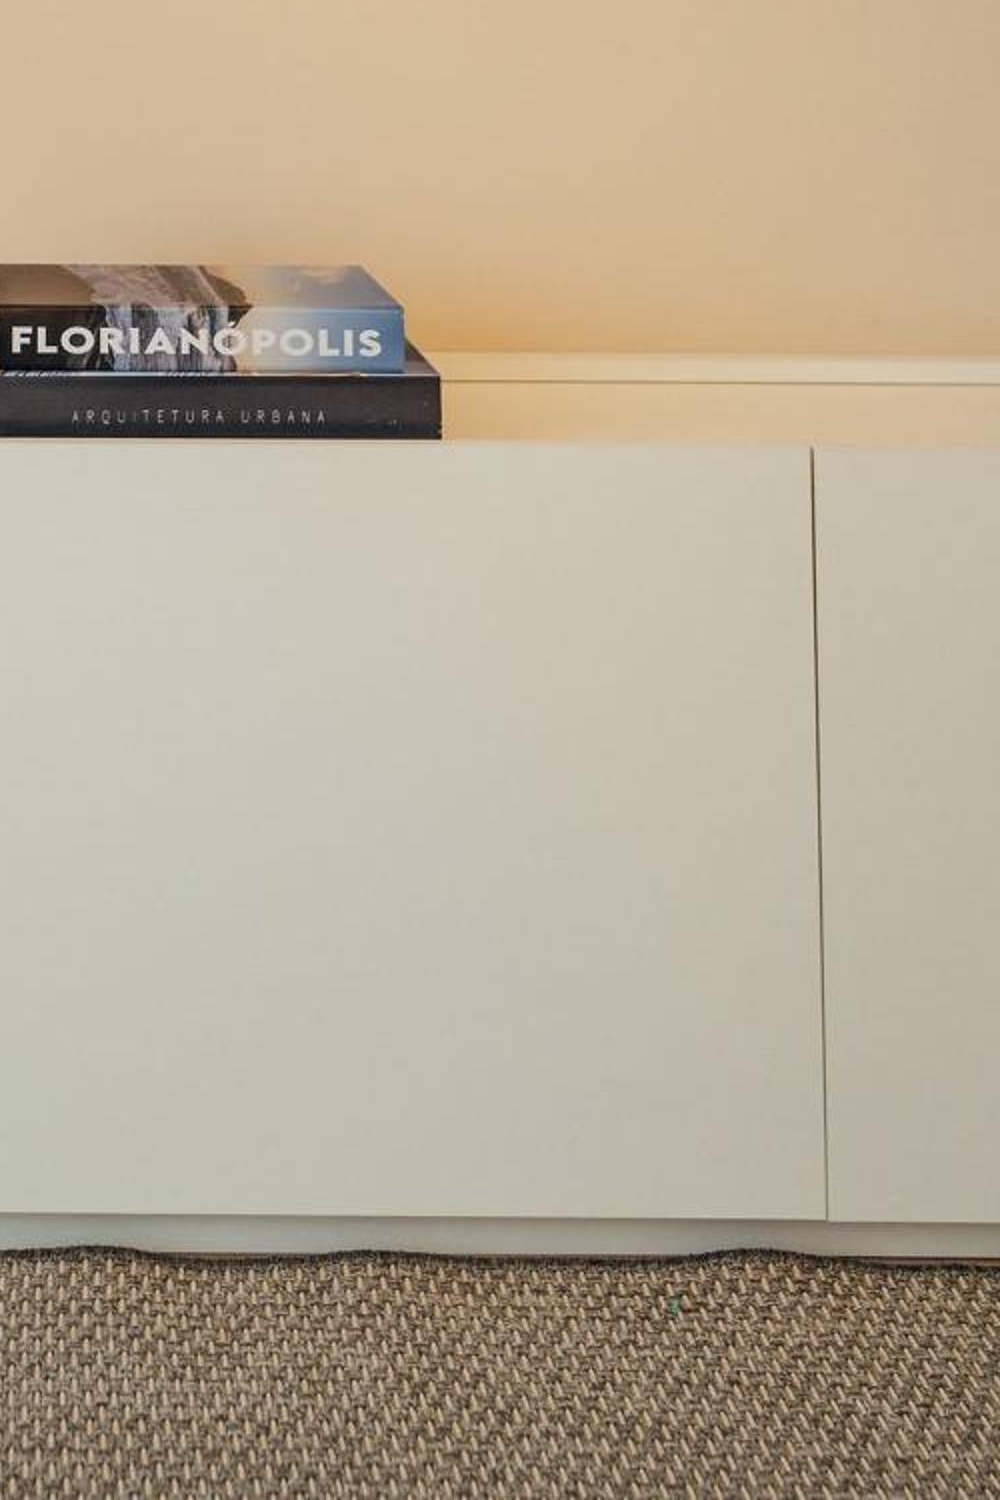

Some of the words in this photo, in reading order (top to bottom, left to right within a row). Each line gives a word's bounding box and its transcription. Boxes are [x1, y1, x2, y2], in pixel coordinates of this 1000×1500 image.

[11, 321, 382, 357] FLORIANÓPOLIS
[71, 409, 224, 425] ARQUITETURA
[241, 409, 326, 424] URBANA
